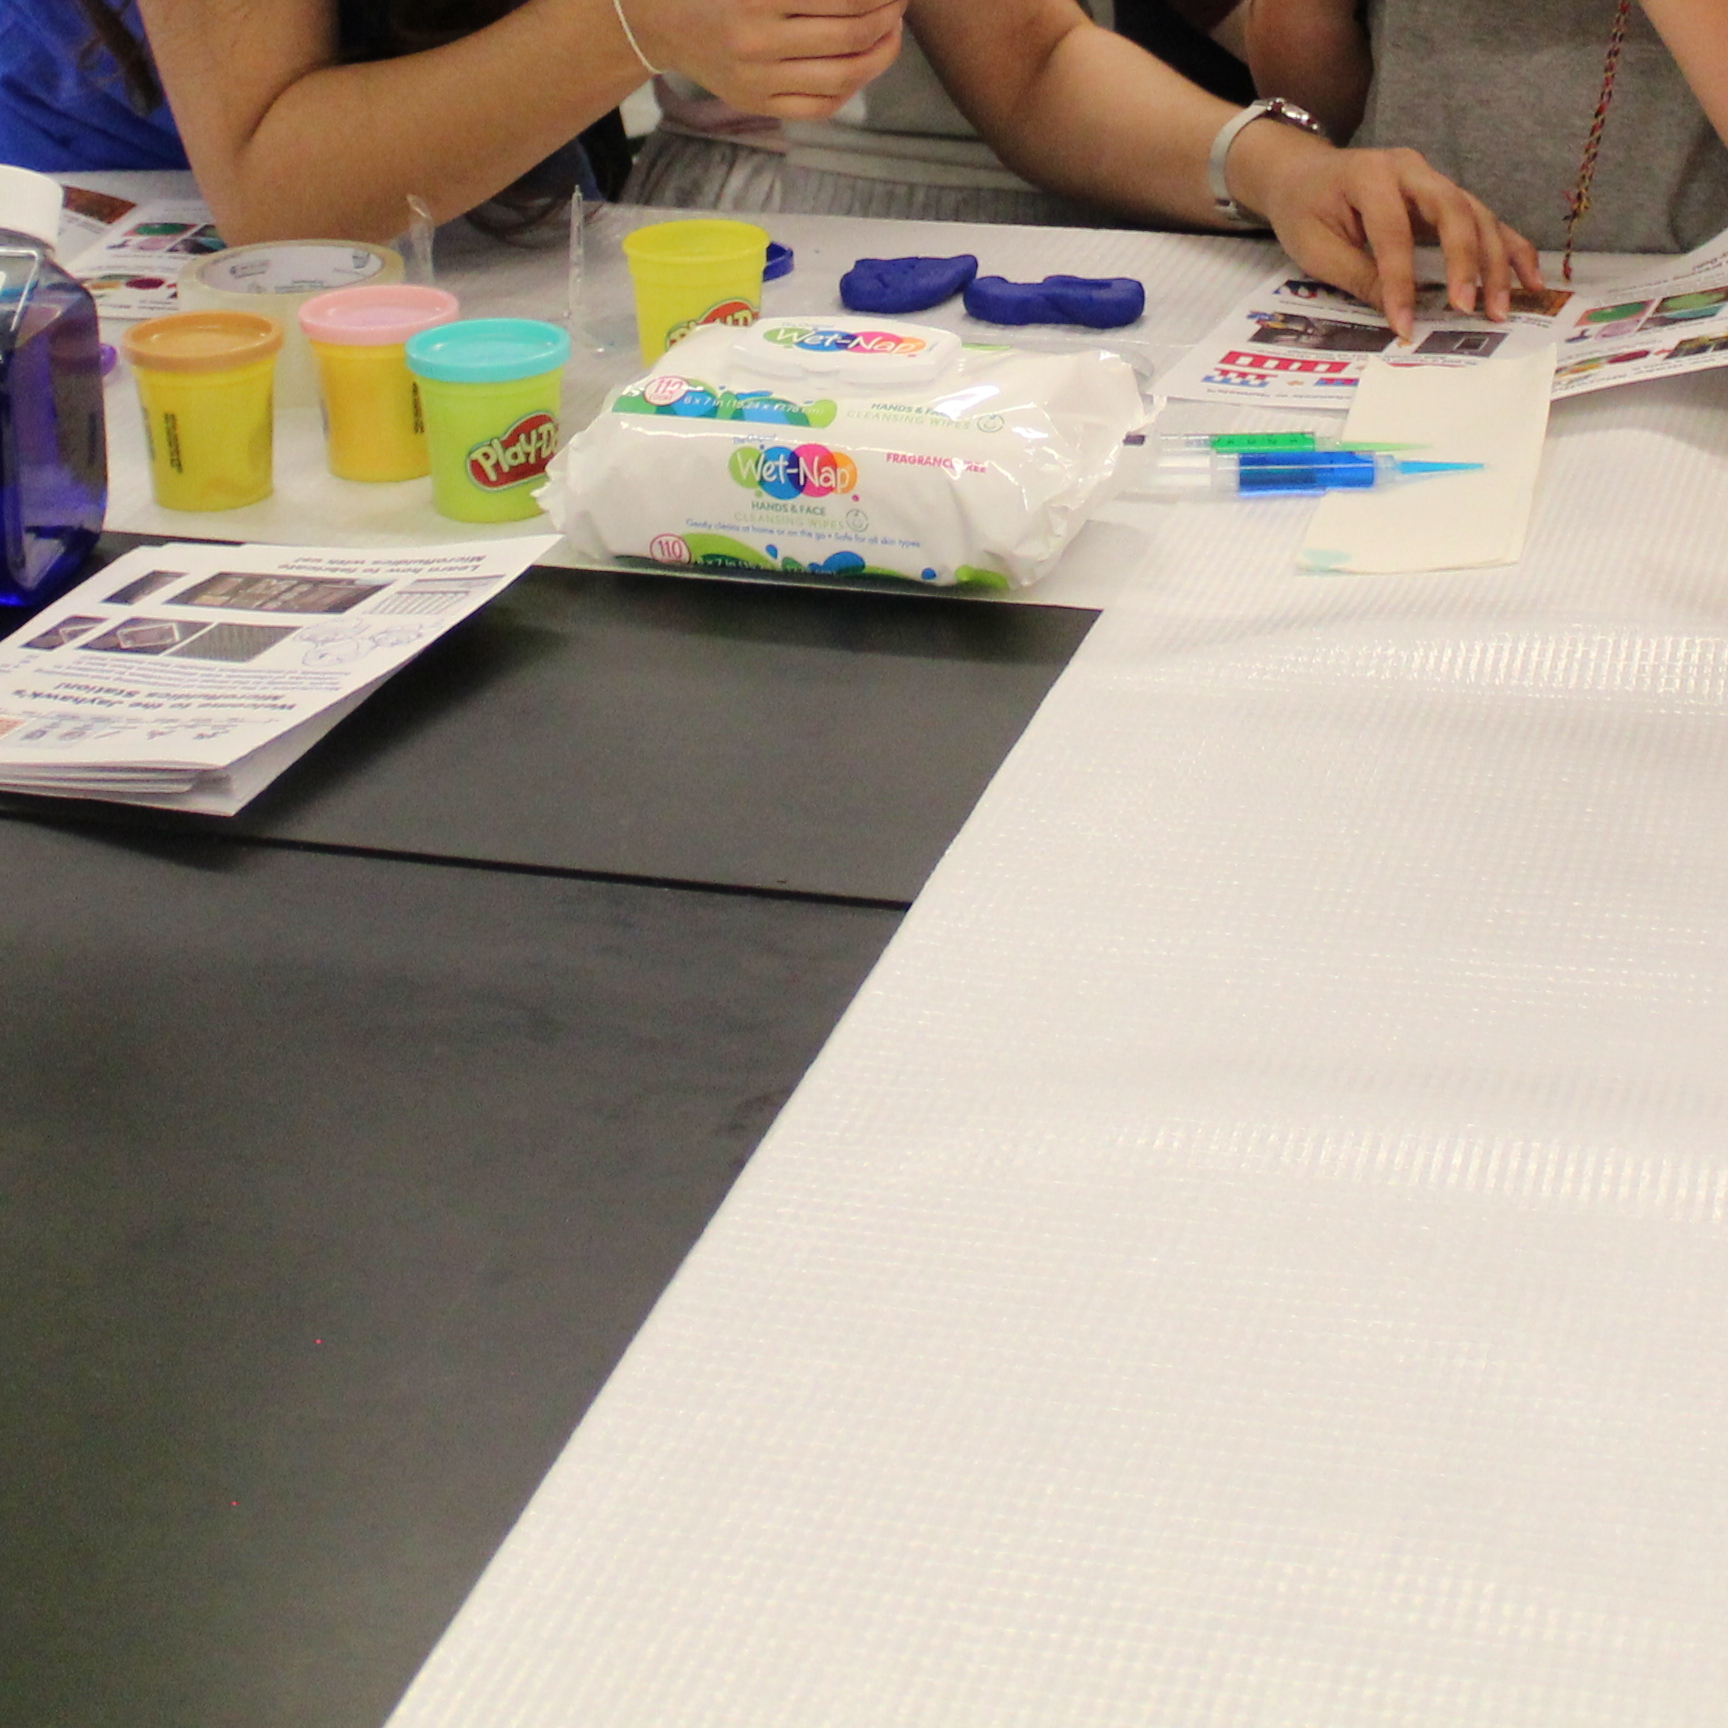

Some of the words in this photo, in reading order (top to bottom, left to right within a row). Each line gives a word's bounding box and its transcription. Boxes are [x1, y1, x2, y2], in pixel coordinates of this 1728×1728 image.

[777, 328, 919, 354] Wet-Nap
[871, 403, 912, 413] HANDS
[847, 409, 925, 425] CLEANSING
[929, 417, 970, 430] WIPES
[737, 452, 851, 493] Wet-Nap
[751, 501, 788, 513] HANDS
[791, 505, 799, 514] &
[799, 505, 826, 516] FACE
[734, 511, 804, 527] CLEANSING
[809, 517, 845, 530] WIPES
[686, 518, 712, 531] Gently
[752, 525, 775, 535] home
[787, 529, 798, 537] on
[800, 528, 813, 538] the
[815, 532, 826, 541] go
[880, 536, 896, 546] skin
[898, 538, 920, 548] types
[657, 539, 683, 559] 110
[292, 556, 324, 565] us!
[329, 558, 365, 566] with
[372, 555, 487, 565] Microfluidics
[277, 563, 358, 575] fabricate
[362, 567, 381, 575] to
[386, 567, 424, 575] how
[428, 564, 480, 574] Learn
[53, 682, 141, 701] Station!
[144, 691, 285, 703] Microfluidics
[10, 688, 124, 709] Jayhawk's
[129, 700, 164, 712] the
[168, 702, 191, 712] to
[196, 701, 297, 713] Welcome
